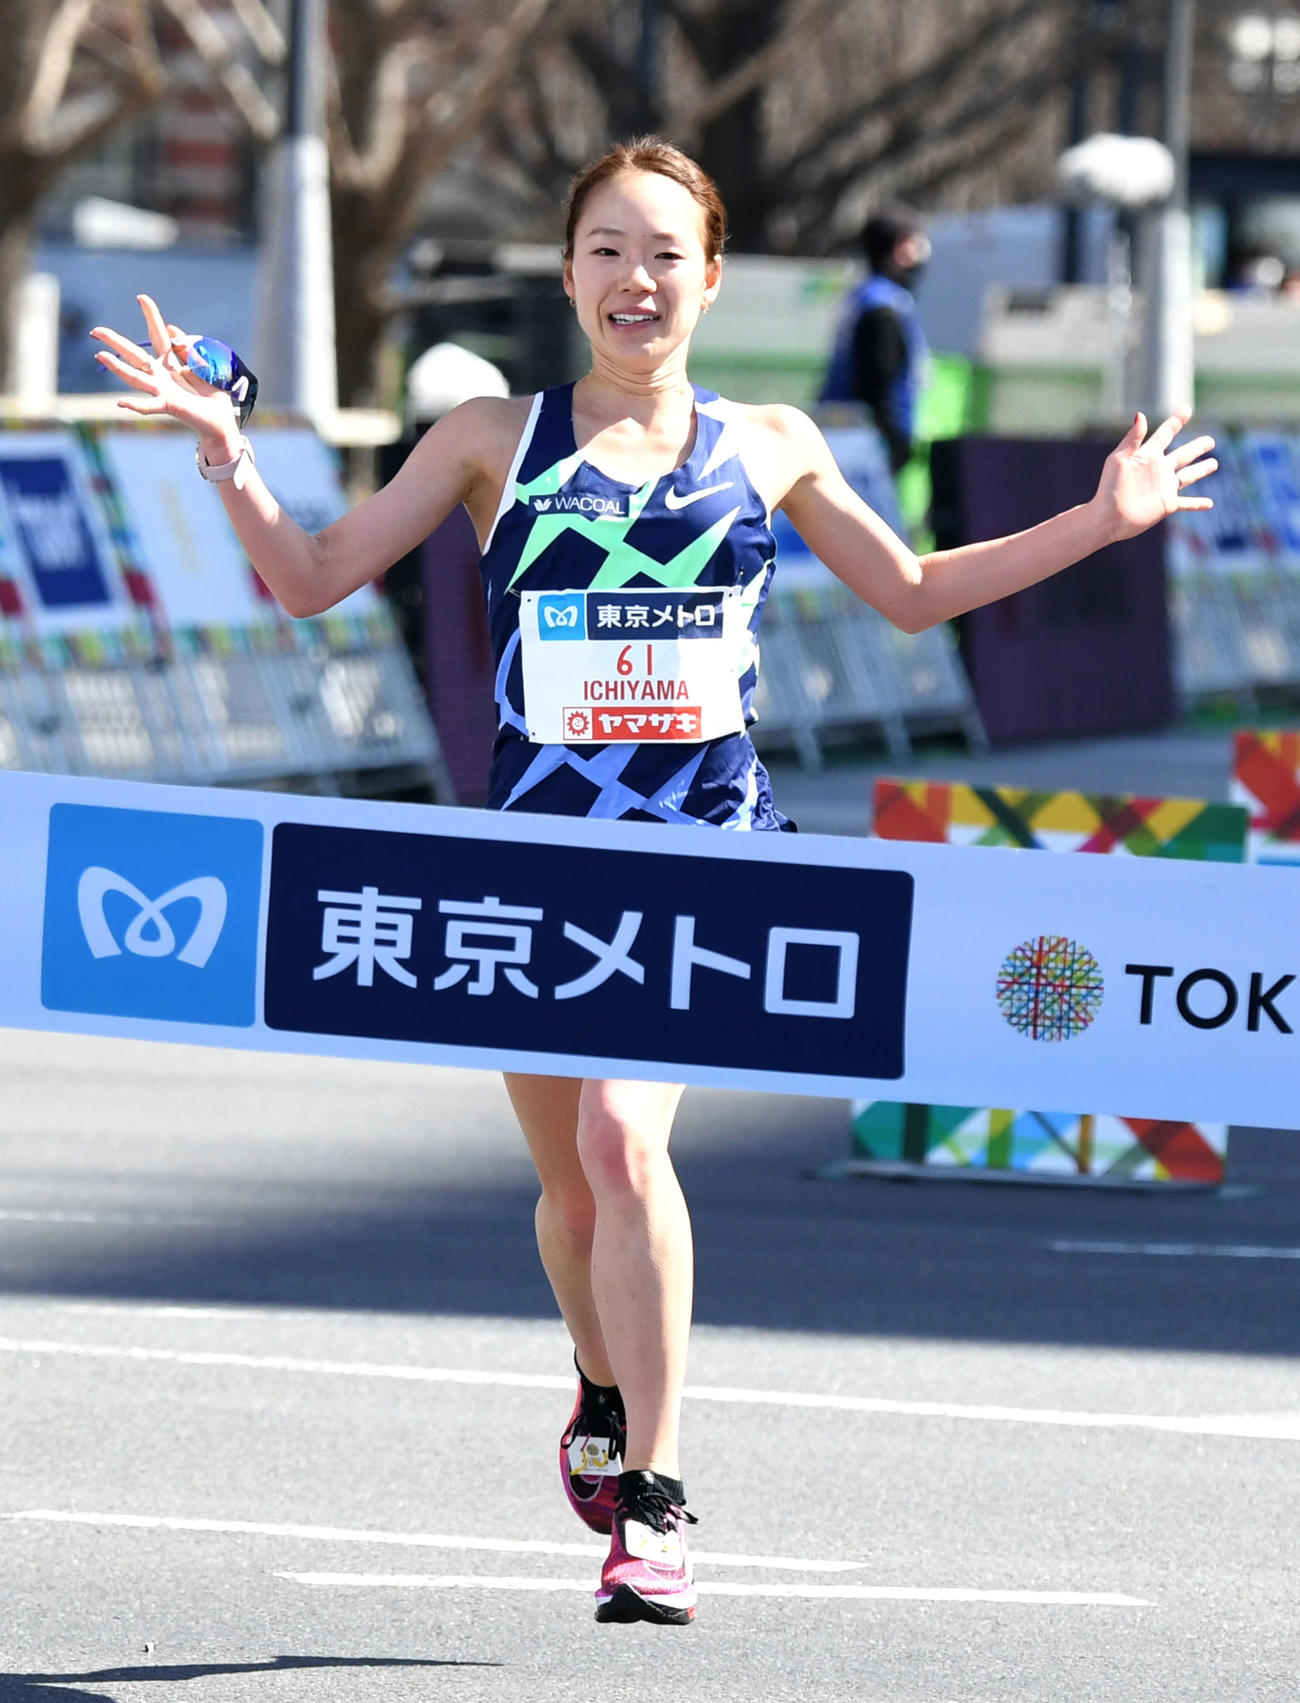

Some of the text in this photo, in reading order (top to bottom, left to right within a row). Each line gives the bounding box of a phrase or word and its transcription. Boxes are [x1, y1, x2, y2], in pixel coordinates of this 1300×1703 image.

[555, 496, 625, 515] WACOAL
[597, 604, 715, 628] 東京メトロ
[616, 644, 653, 676] 61
[584, 680, 689, 701] ICHIYAMA
[598, 713, 697, 733] ヤマザキ
[311, 885, 860, 1019] 東京メトロ
[1125, 963, 1297, 1035] TOK
